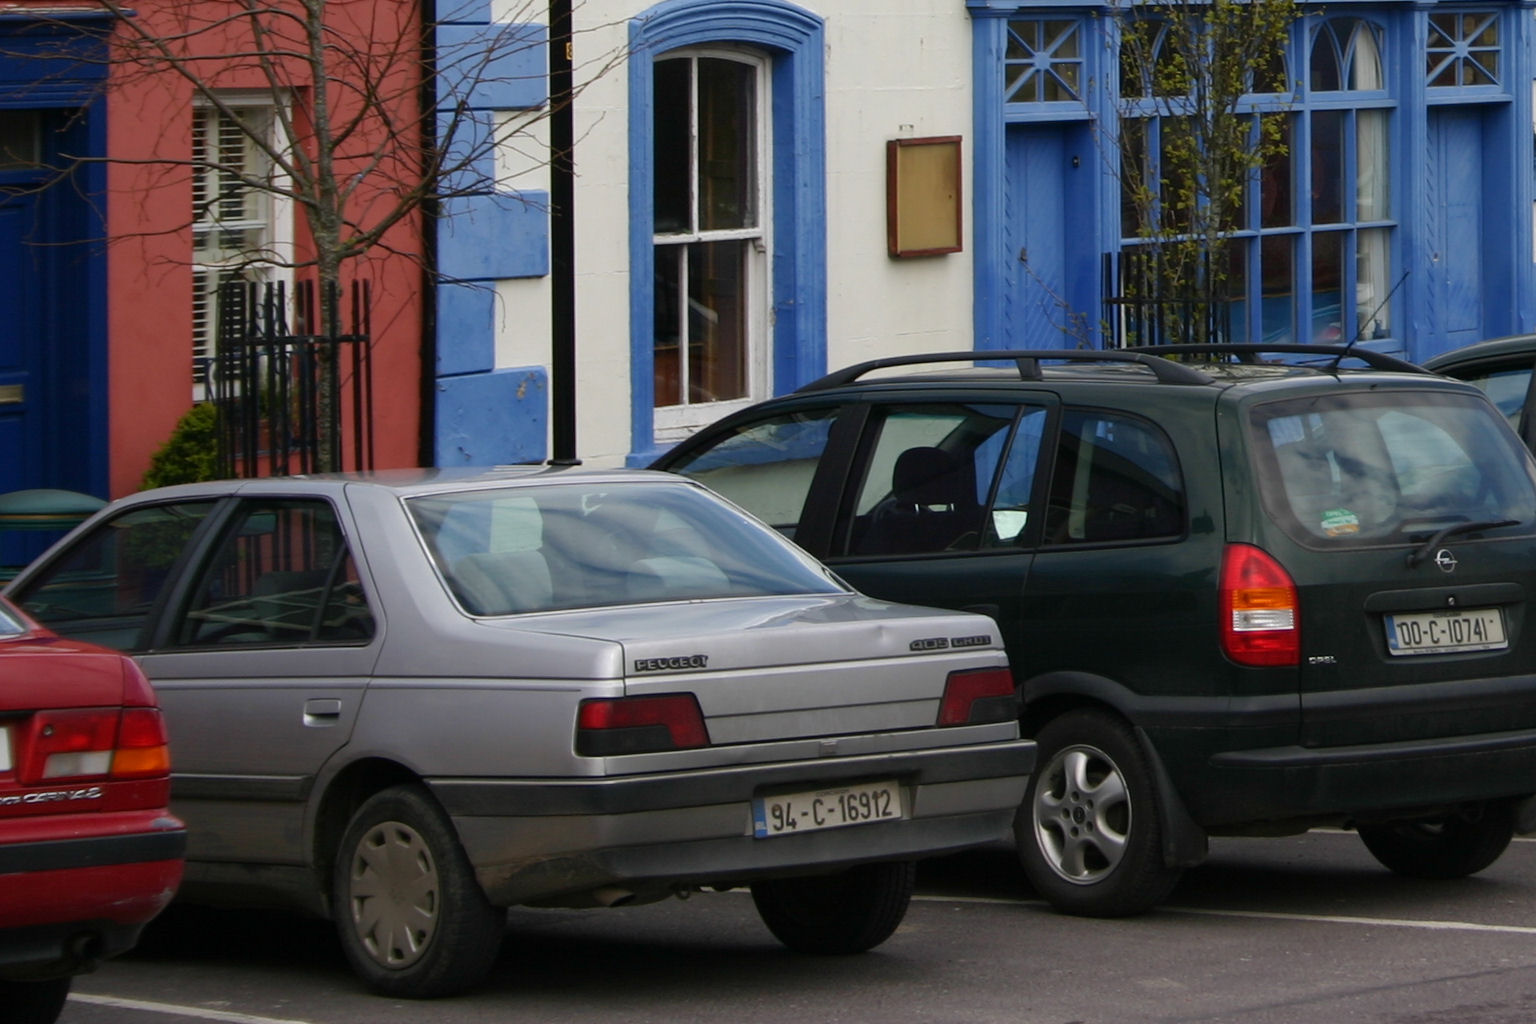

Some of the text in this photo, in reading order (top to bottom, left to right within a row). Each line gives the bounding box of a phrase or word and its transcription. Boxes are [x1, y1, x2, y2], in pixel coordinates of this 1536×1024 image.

[1400, 617, 1488, 646] 00-C-10741
[909, 637, 949, 651] 405
[635, 655, 709, 672] PEUGEOT
[771, 789, 893, 832] 94-C-16912
